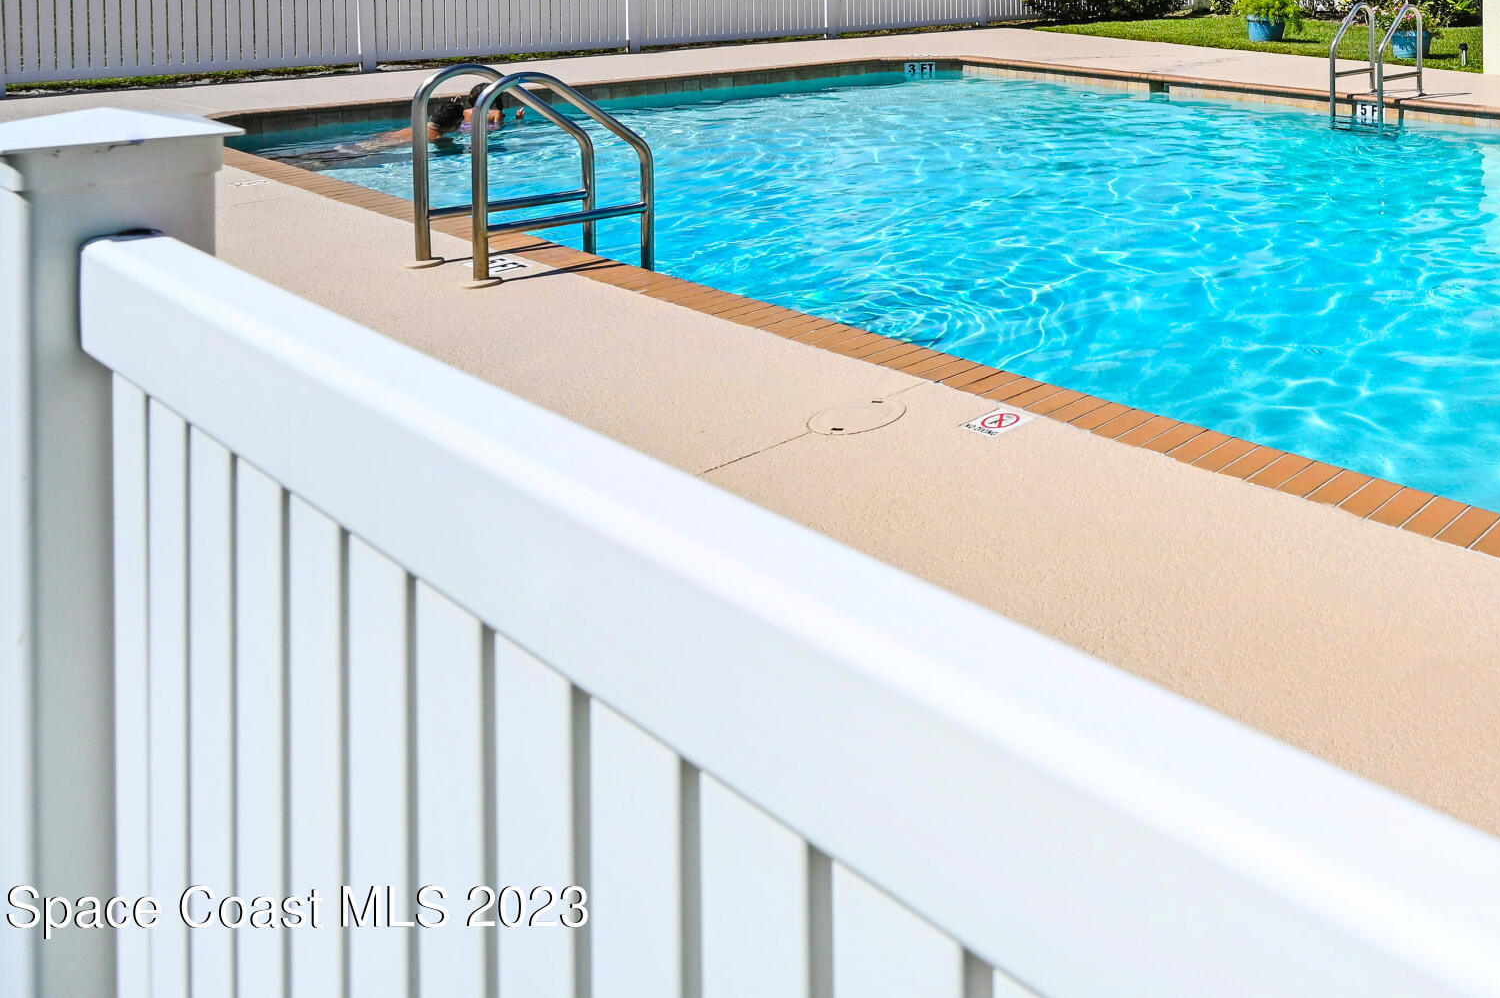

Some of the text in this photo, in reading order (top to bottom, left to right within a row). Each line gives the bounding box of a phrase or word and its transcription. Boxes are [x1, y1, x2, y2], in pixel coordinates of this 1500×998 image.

[908, 63, 935, 73] 3 FT
[1360, 104, 1384, 117] 5 F
